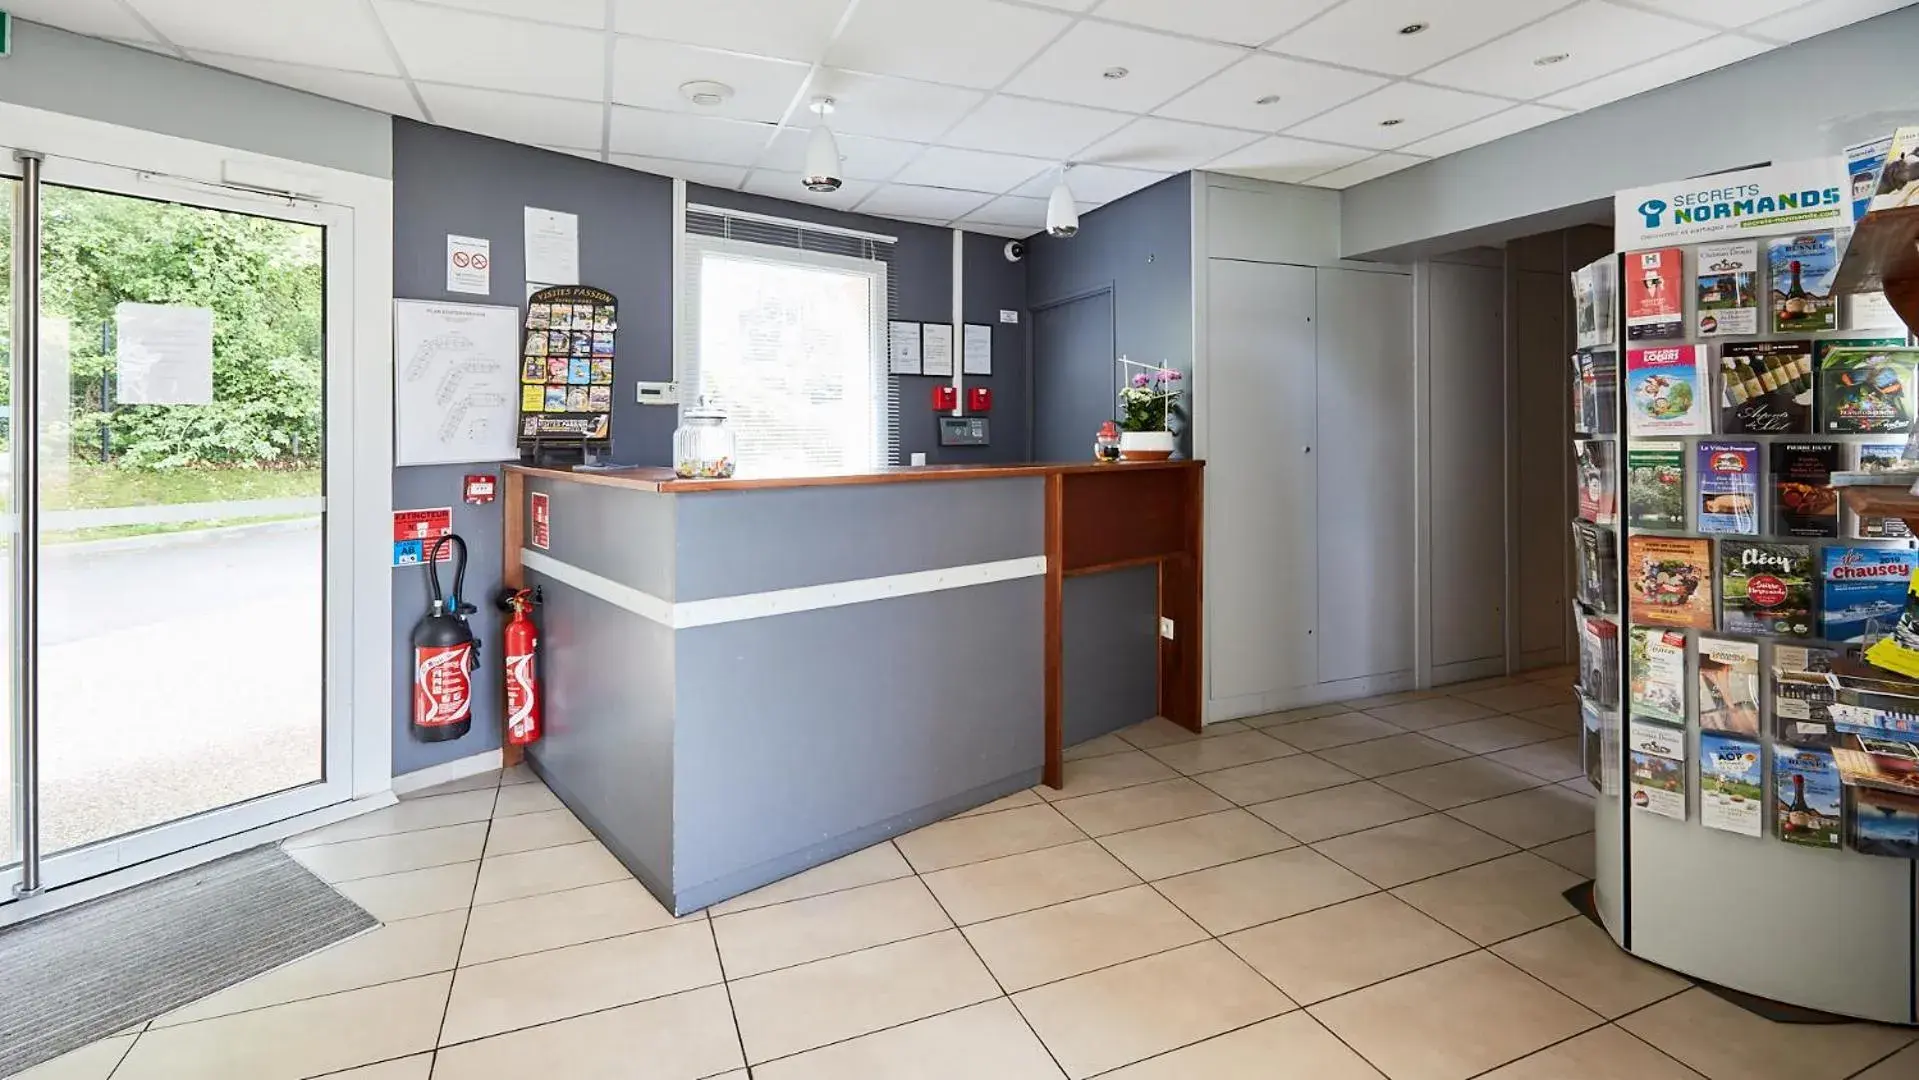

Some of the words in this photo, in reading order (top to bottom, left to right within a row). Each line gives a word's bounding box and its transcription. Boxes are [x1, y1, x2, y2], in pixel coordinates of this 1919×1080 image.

[1674, 183, 1760, 207] SECRETS
[1674, 187, 1841, 225] NORMANDS
[1742, 209, 1840, 228] secrets-normands.com
[538, 288, 571, 301] VISITES
[573, 288, 613, 303] PASSION
[395, 511, 449, 520] EXTINCTEUR
[1741, 549, 1791, 573] Clécy
[1832, 563, 1910, 580] Chausey
